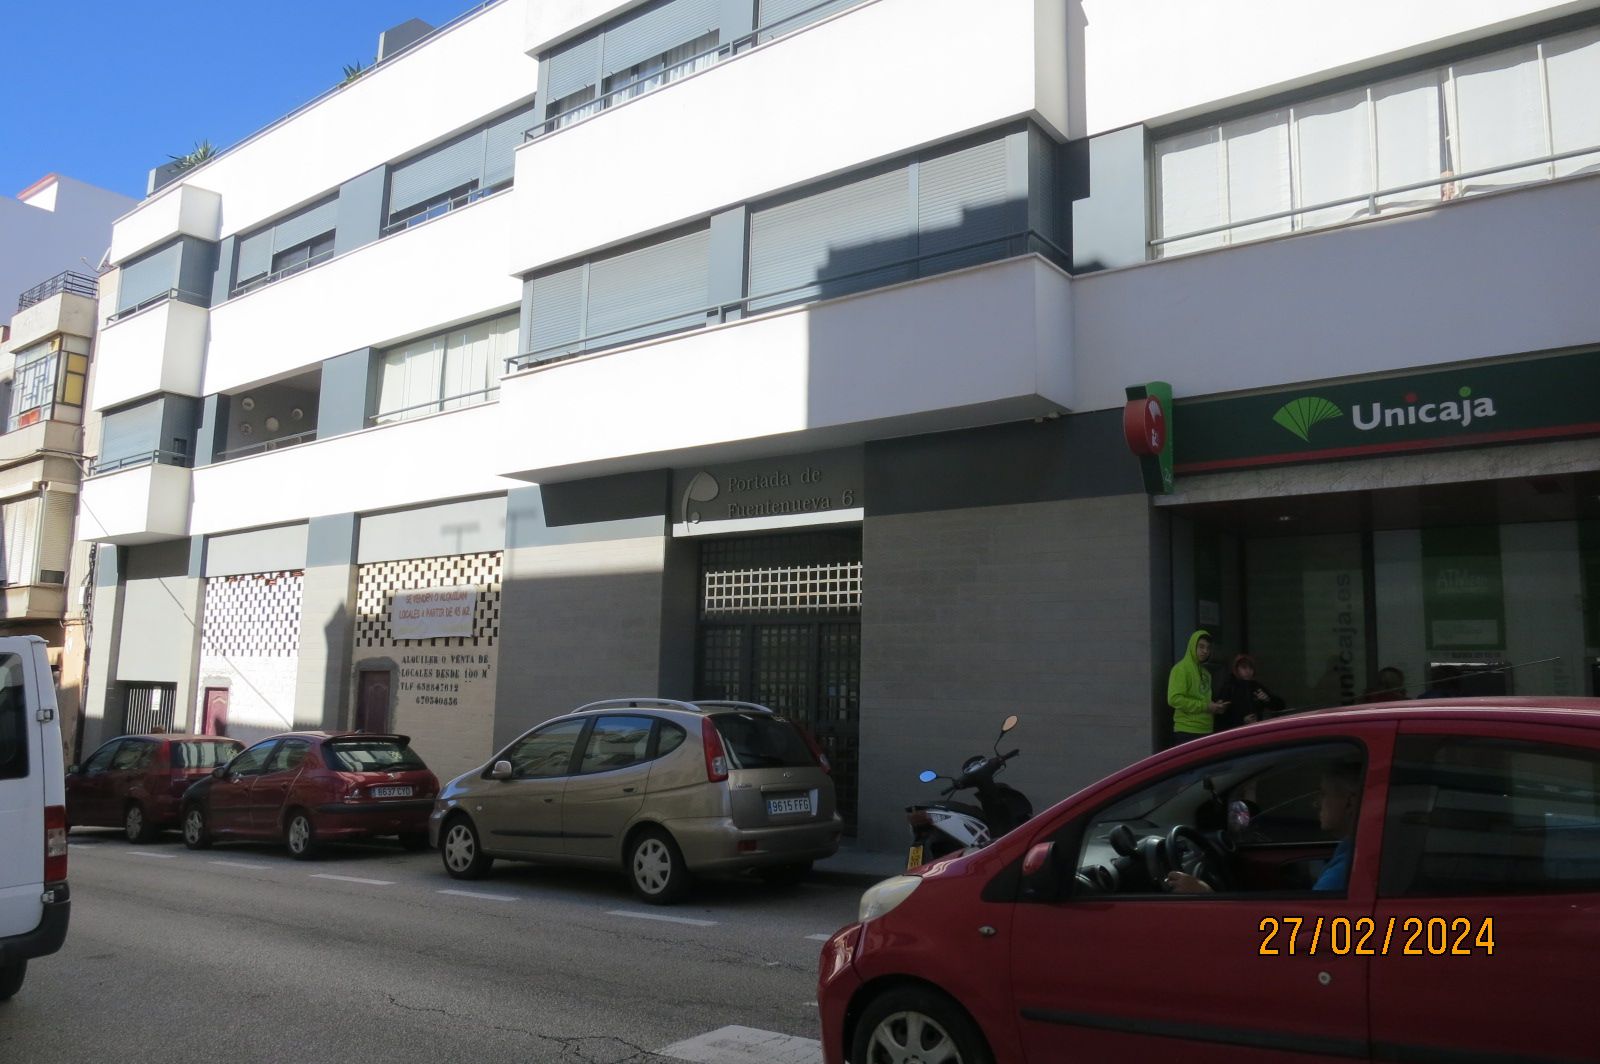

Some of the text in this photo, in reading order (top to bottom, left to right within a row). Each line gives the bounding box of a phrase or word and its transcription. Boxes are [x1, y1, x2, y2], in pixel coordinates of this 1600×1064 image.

[1352, 385, 1497, 432] Unicaja
[727, 466, 822, 493] Portada de
[727, 488, 854, 518] Fuentenueva 6
[402, 654, 489, 664] ALQUILER O VENTA DE
[401, 668, 433, 678] LOCALES
[435, 669, 459, 679] DESDE
[401, 682, 413, 690] TLF
[772, 799, 809, 812] 9615 FFG
